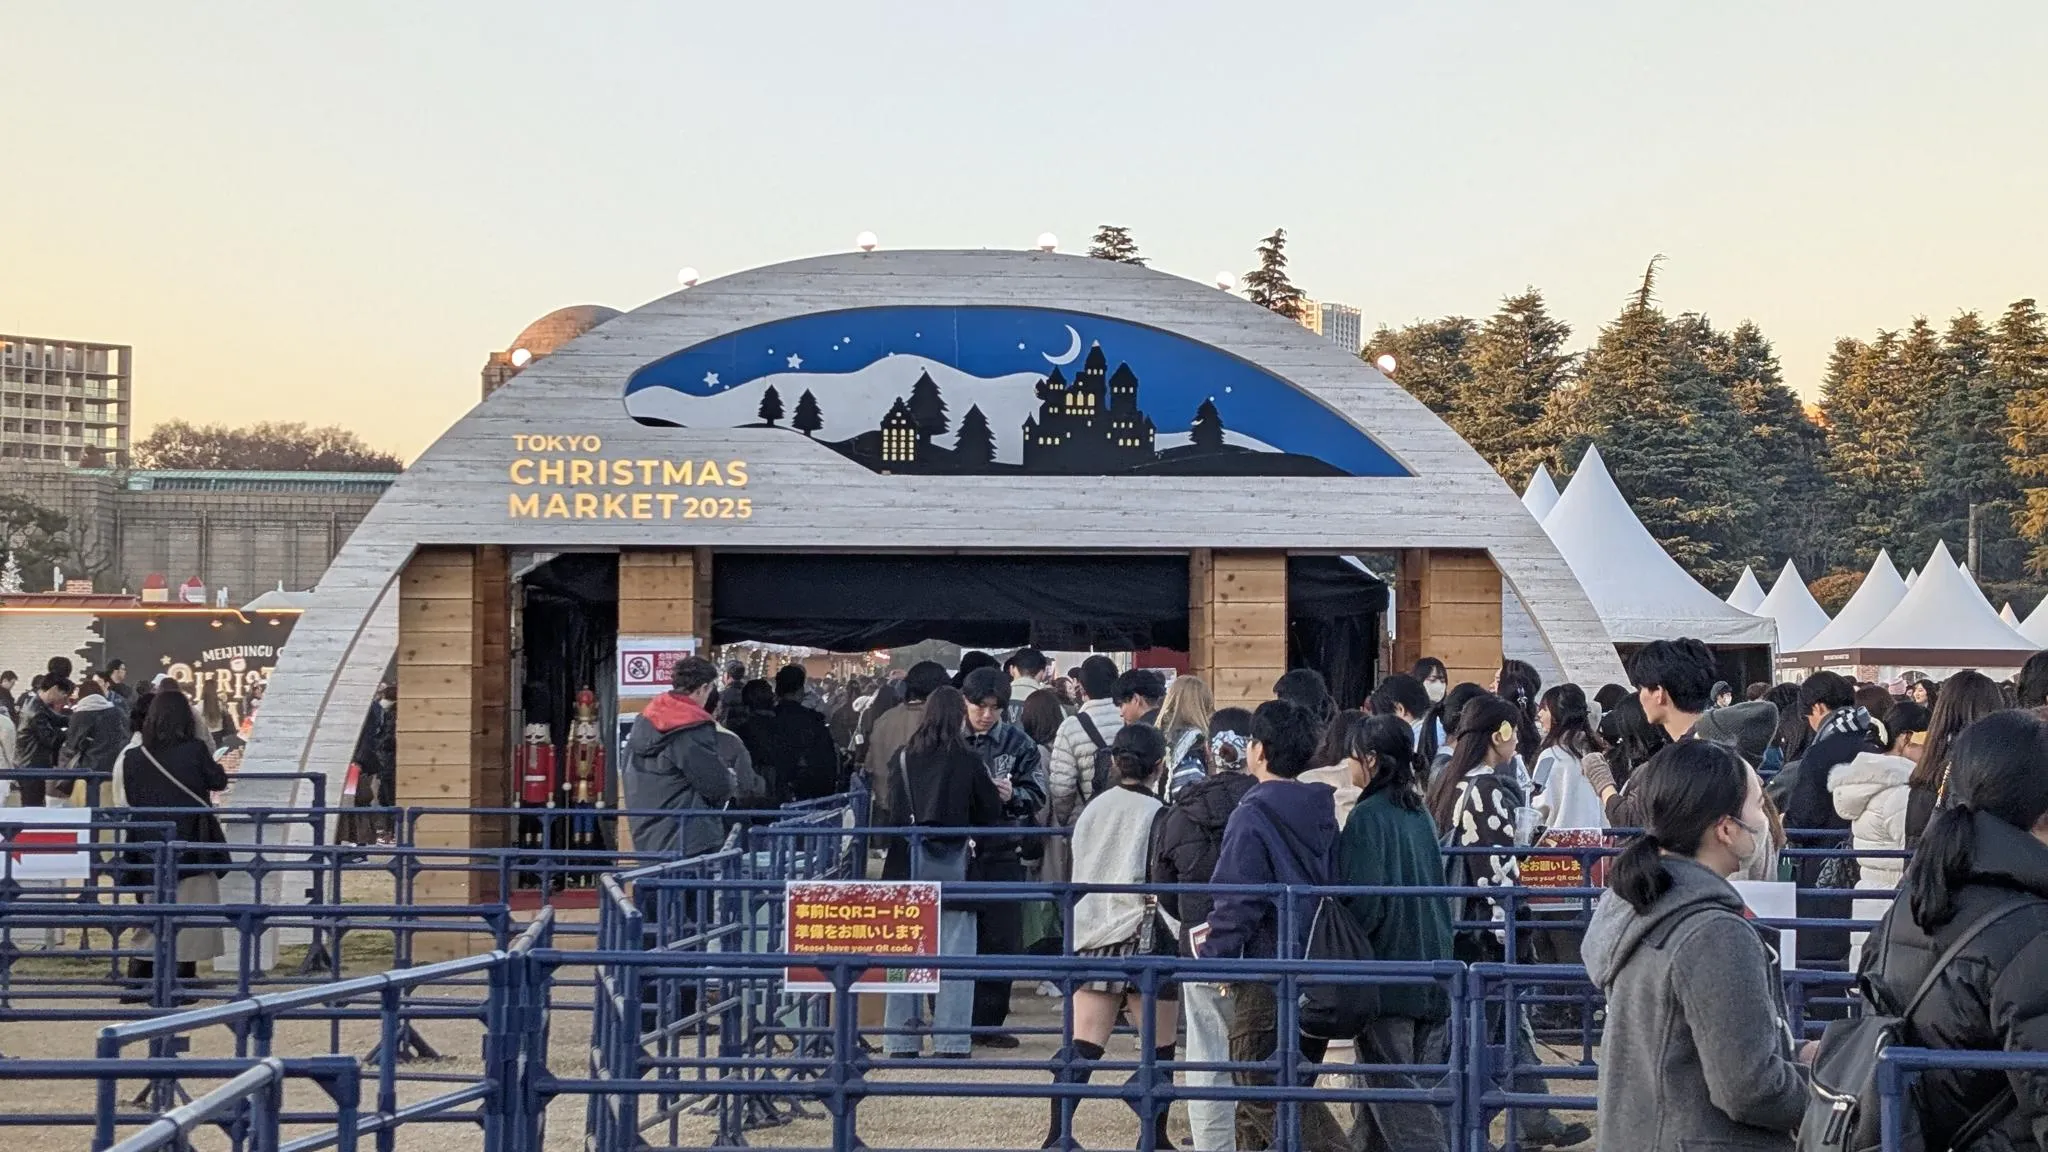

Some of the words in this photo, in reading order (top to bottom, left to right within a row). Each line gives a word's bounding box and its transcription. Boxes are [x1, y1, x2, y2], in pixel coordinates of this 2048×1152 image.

[512, 434, 602, 453] TOKYO
[509, 458, 749, 487] CHRISTMAS
[509, 492, 680, 519] MARKET
[682, 497, 753, 519] 2025
[202, 645, 273, 662] MEIJIJINGU
[795, 904, 920, 919] 事前にQRコードの
[794, 944, 825, 952] Please
[826, 944, 850, 952] have
[851, 945, 873, 953] your
[875, 944, 889, 953] QR
[890, 944, 913, 953] code
